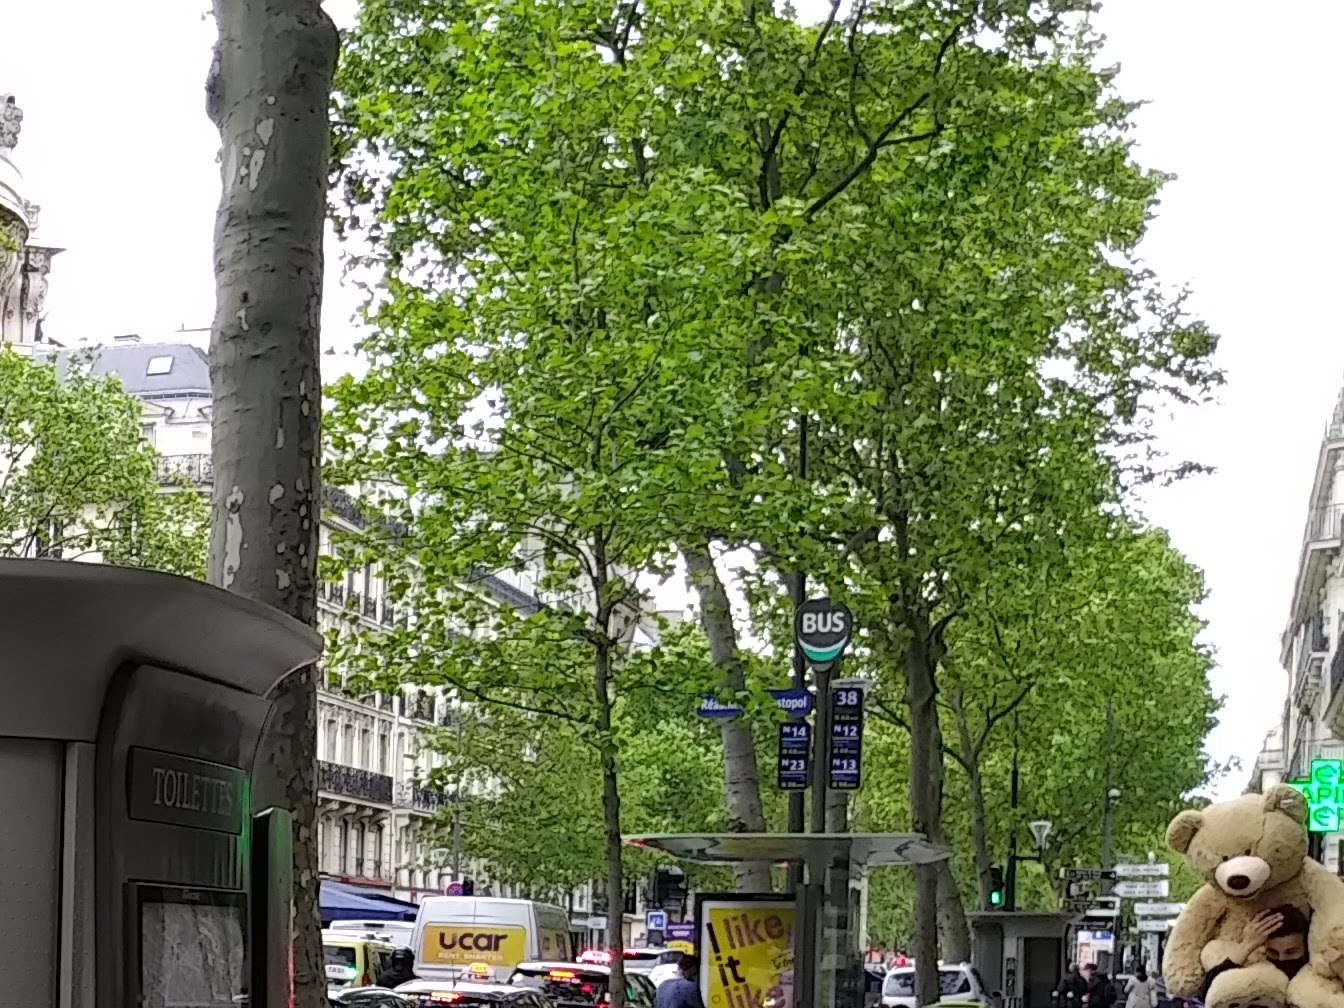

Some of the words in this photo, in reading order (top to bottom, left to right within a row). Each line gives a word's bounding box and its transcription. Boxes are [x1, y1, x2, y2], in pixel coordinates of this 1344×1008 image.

[802, 612, 845, 633] BUS
[836, 691, 858, 706] 38
[782, 726, 806, 738] N14
[833, 724, 858, 737] N12
[781, 759, 805, 771] N23
[832, 759, 857, 770] N13
[152, 767, 233, 817] TOILETTES
[723, 913, 784, 950] like
[439, 931, 508, 952] ucar
[715, 955, 746, 987] it
